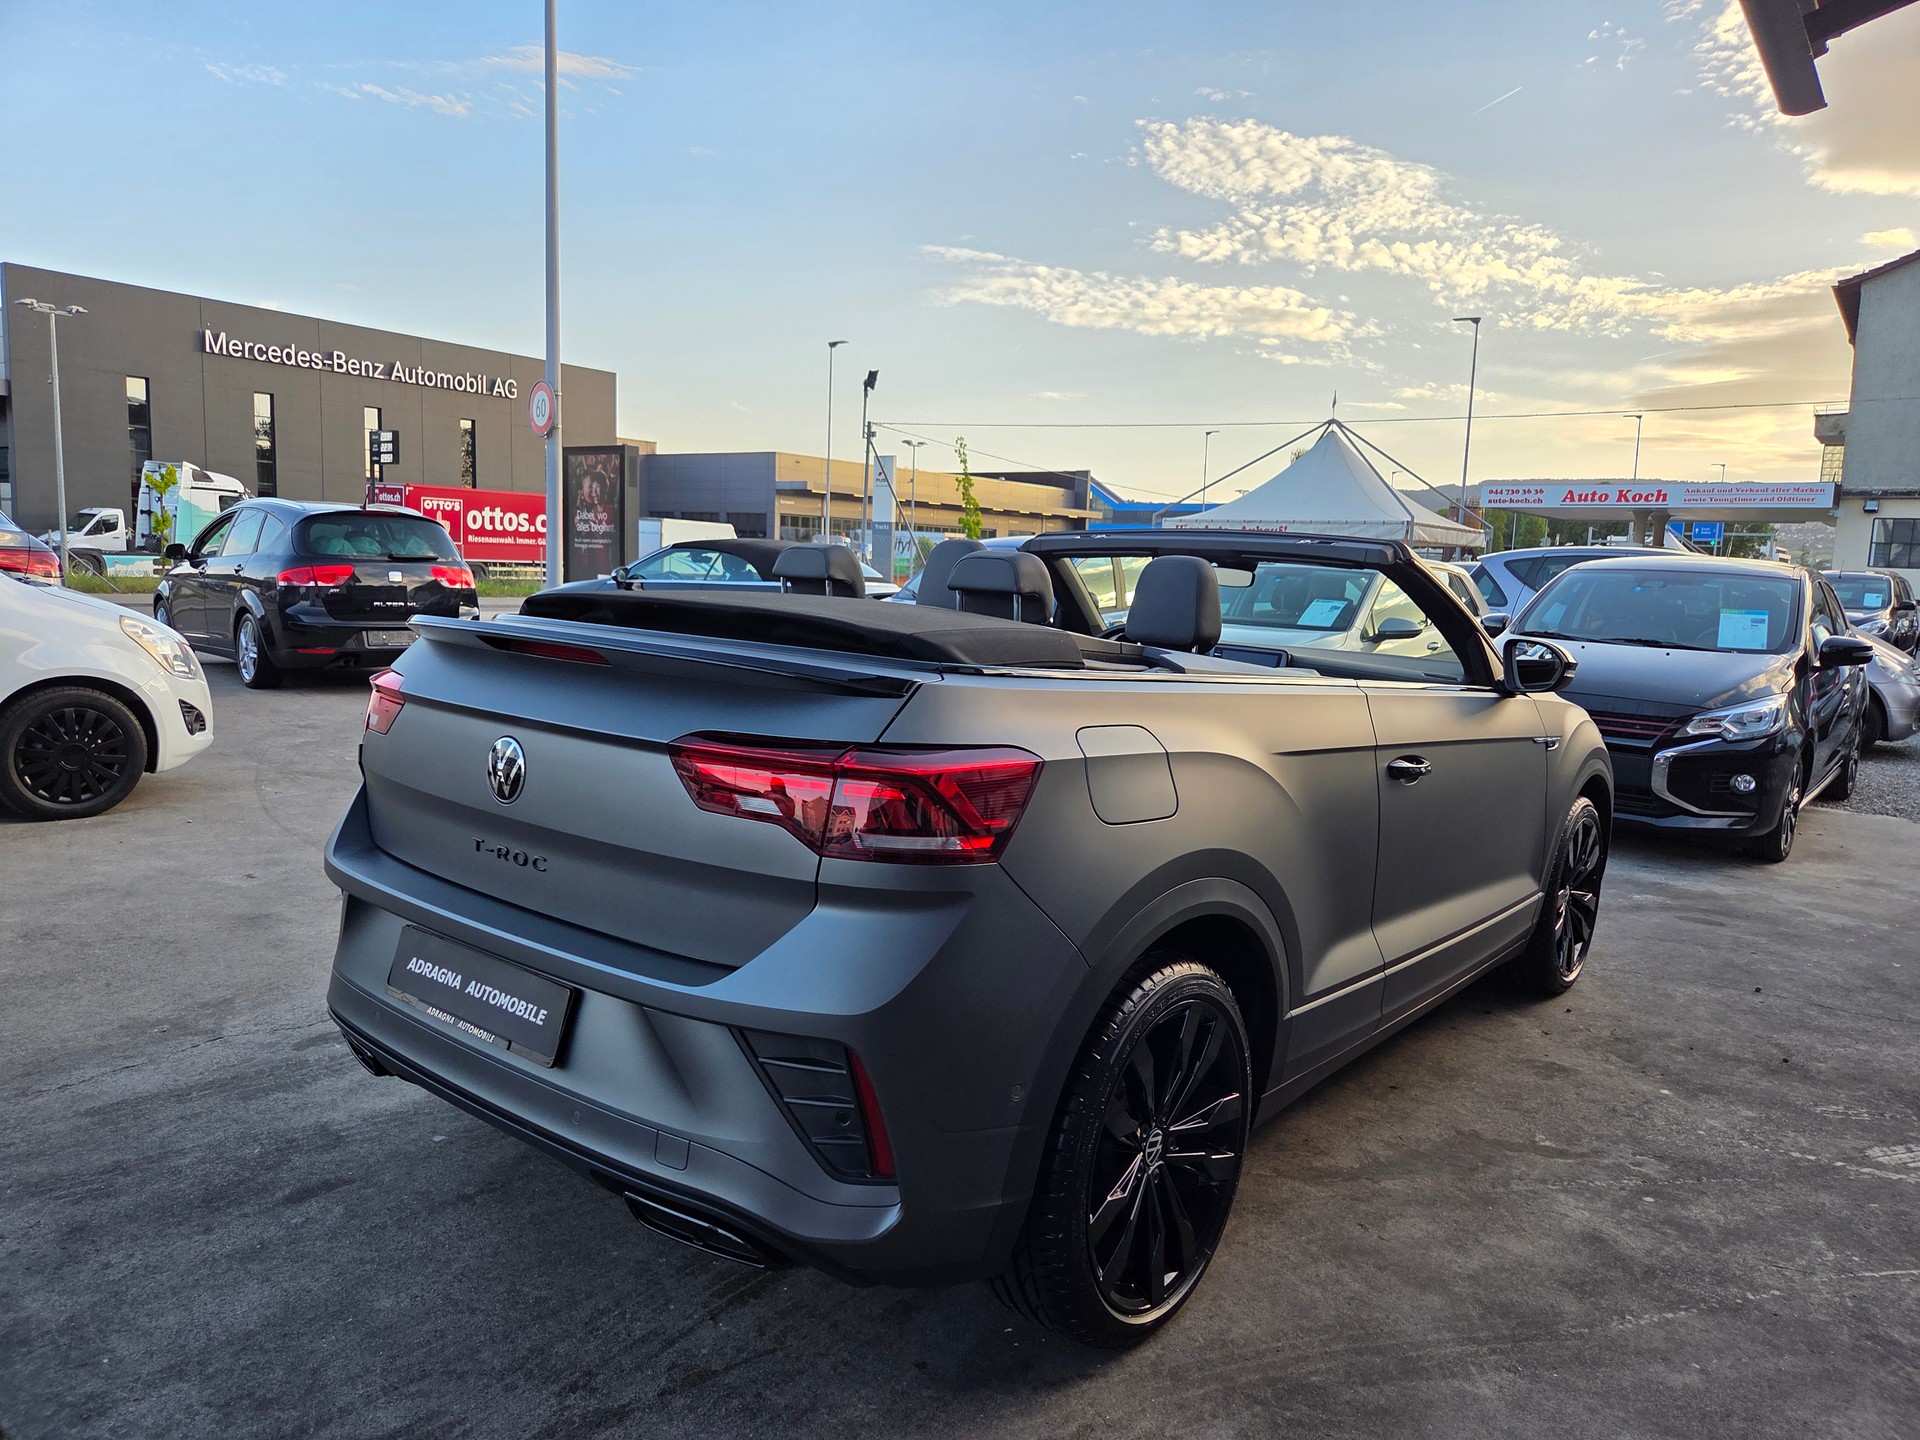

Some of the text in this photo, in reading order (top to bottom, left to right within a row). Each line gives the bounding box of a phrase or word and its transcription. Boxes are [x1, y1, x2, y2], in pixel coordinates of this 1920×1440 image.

[205, 329, 518, 399] Mercedes-Benz Automobil AG
[535, 398, 547, 418] 60
[378, 491, 401, 502] ottos.ch
[1505, 488, 1520, 496] 730
[1521, 488, 1532, 496] 36
[1533, 488, 1544, 496] 36
[1561, 489, 1668, 503] Auto Koch
[424, 500, 461, 512] OTTO'S
[1709, 496, 1757, 504] Youngtimer
[467, 506, 547, 533] ottos.c
[597, 512, 608, 520] wo
[576, 522, 590, 532] alles
[468, 534, 515, 544] Riesenauswahl.
[516, 537, 537, 545] Immer.
[472, 836, 548, 873] T-ROC
[406, 956, 548, 1026] ADRAGNA AUTOMOBILE
[426, 1006, 496, 1044] ADRAGNA AUTOMOBILE
